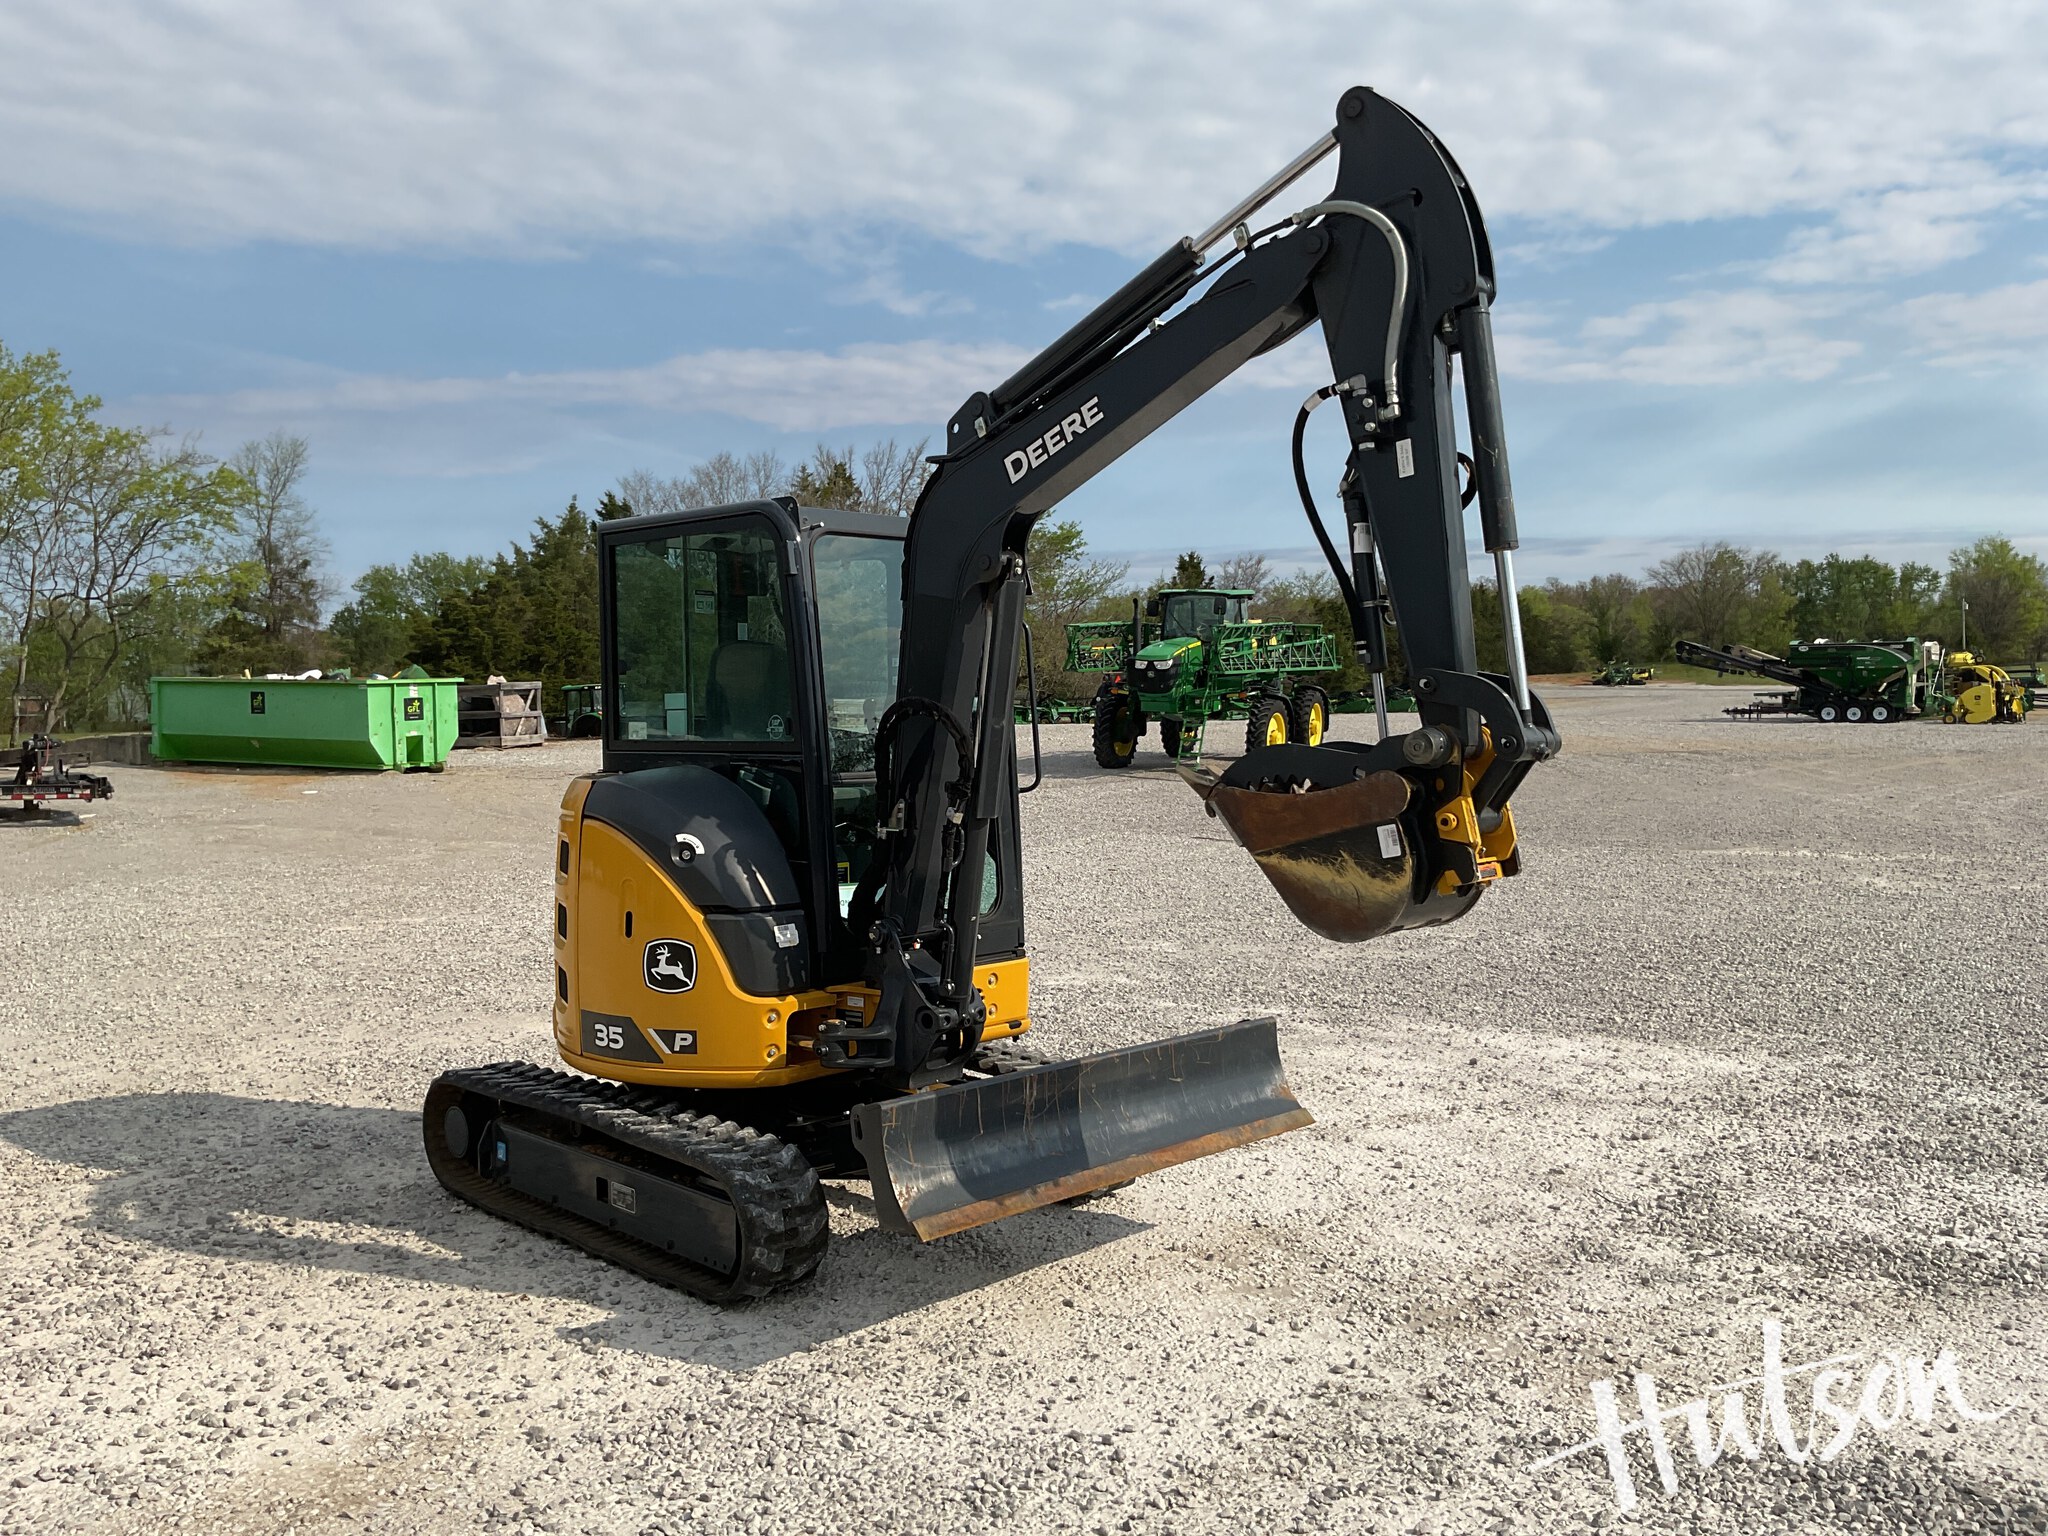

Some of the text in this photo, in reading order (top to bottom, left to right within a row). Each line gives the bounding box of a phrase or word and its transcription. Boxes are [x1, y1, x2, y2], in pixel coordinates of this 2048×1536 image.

[1003, 396, 1105, 484] DEERE
[593, 1023, 693, 1051] 35 P
